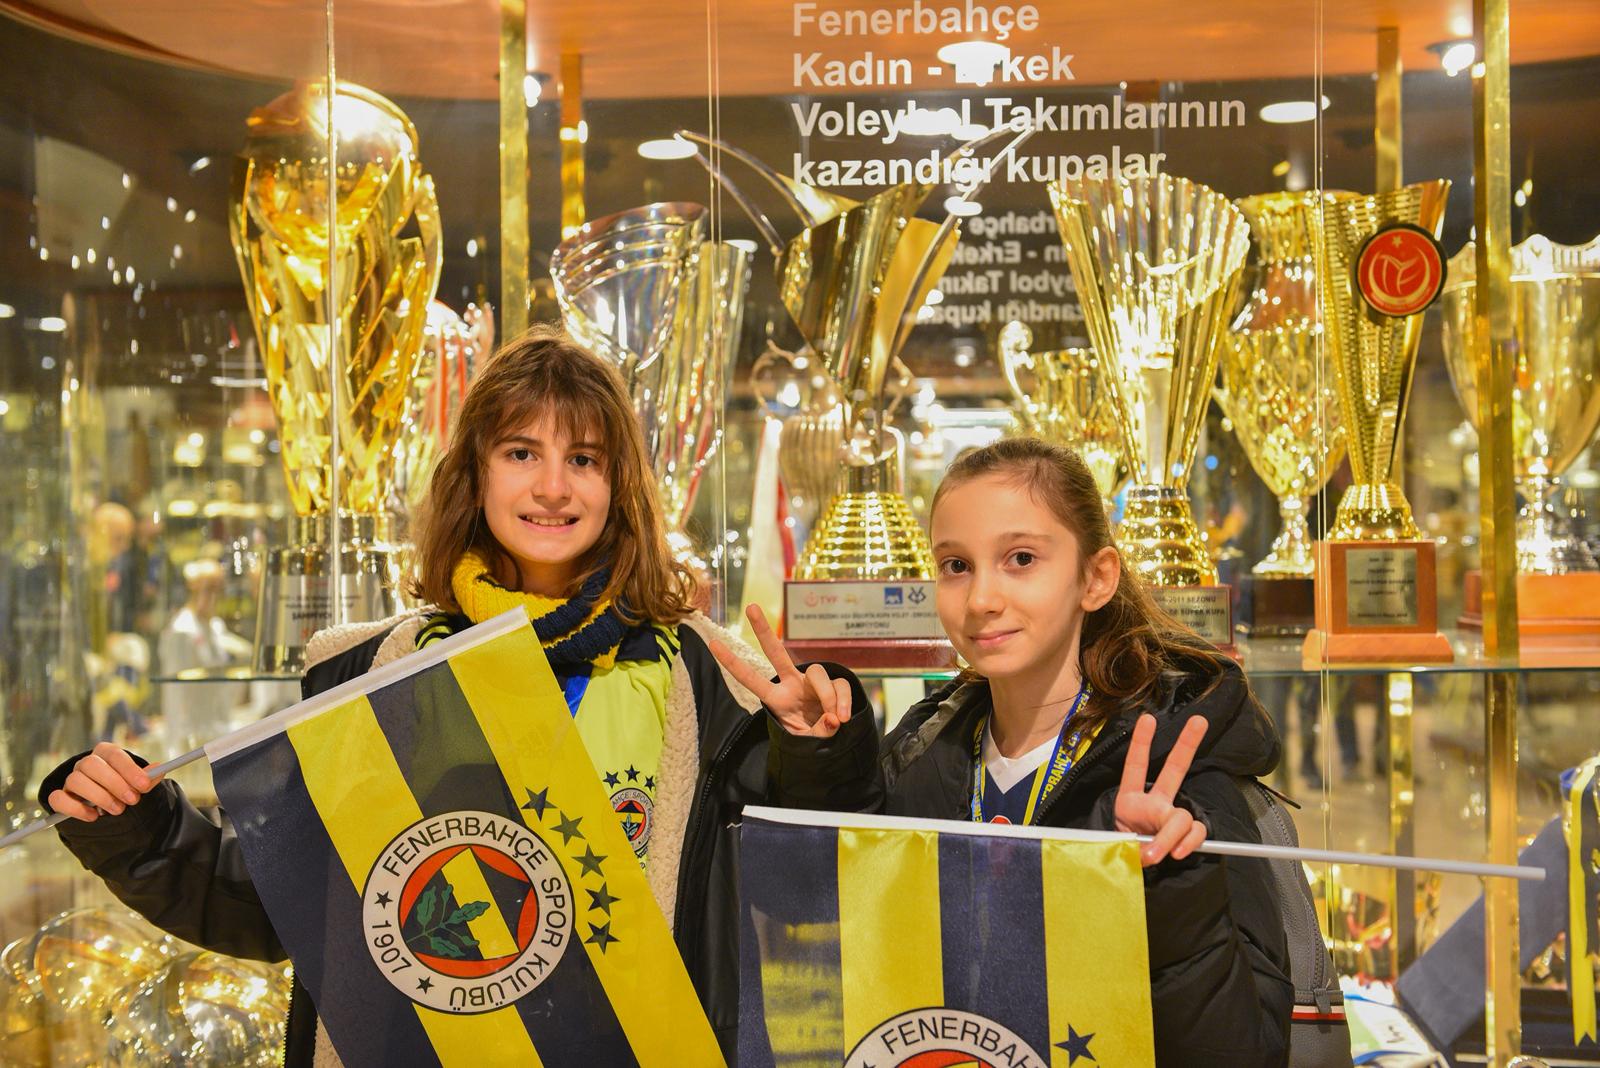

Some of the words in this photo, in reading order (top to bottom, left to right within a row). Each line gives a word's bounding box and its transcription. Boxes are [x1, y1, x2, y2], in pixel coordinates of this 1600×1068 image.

[793, 0, 1040, 41] Fenerbahçe
[793, 51, 912, 87] Kadın
[927, 66, 943, 75] -
[955, 46, 1075, 84] rkek
[984, 95, 1246, 132] Takımlarının
[793, 147, 991, 193] kazandığı
[1006, 145, 1167, 191] kupalar
[382, 816, 548, 877] FENERBAHÇE
[540, 877, 567, 948] SPOR
[371, 919, 412, 974] 1907
[449, 952, 550, 1011] KULÜBÜ
